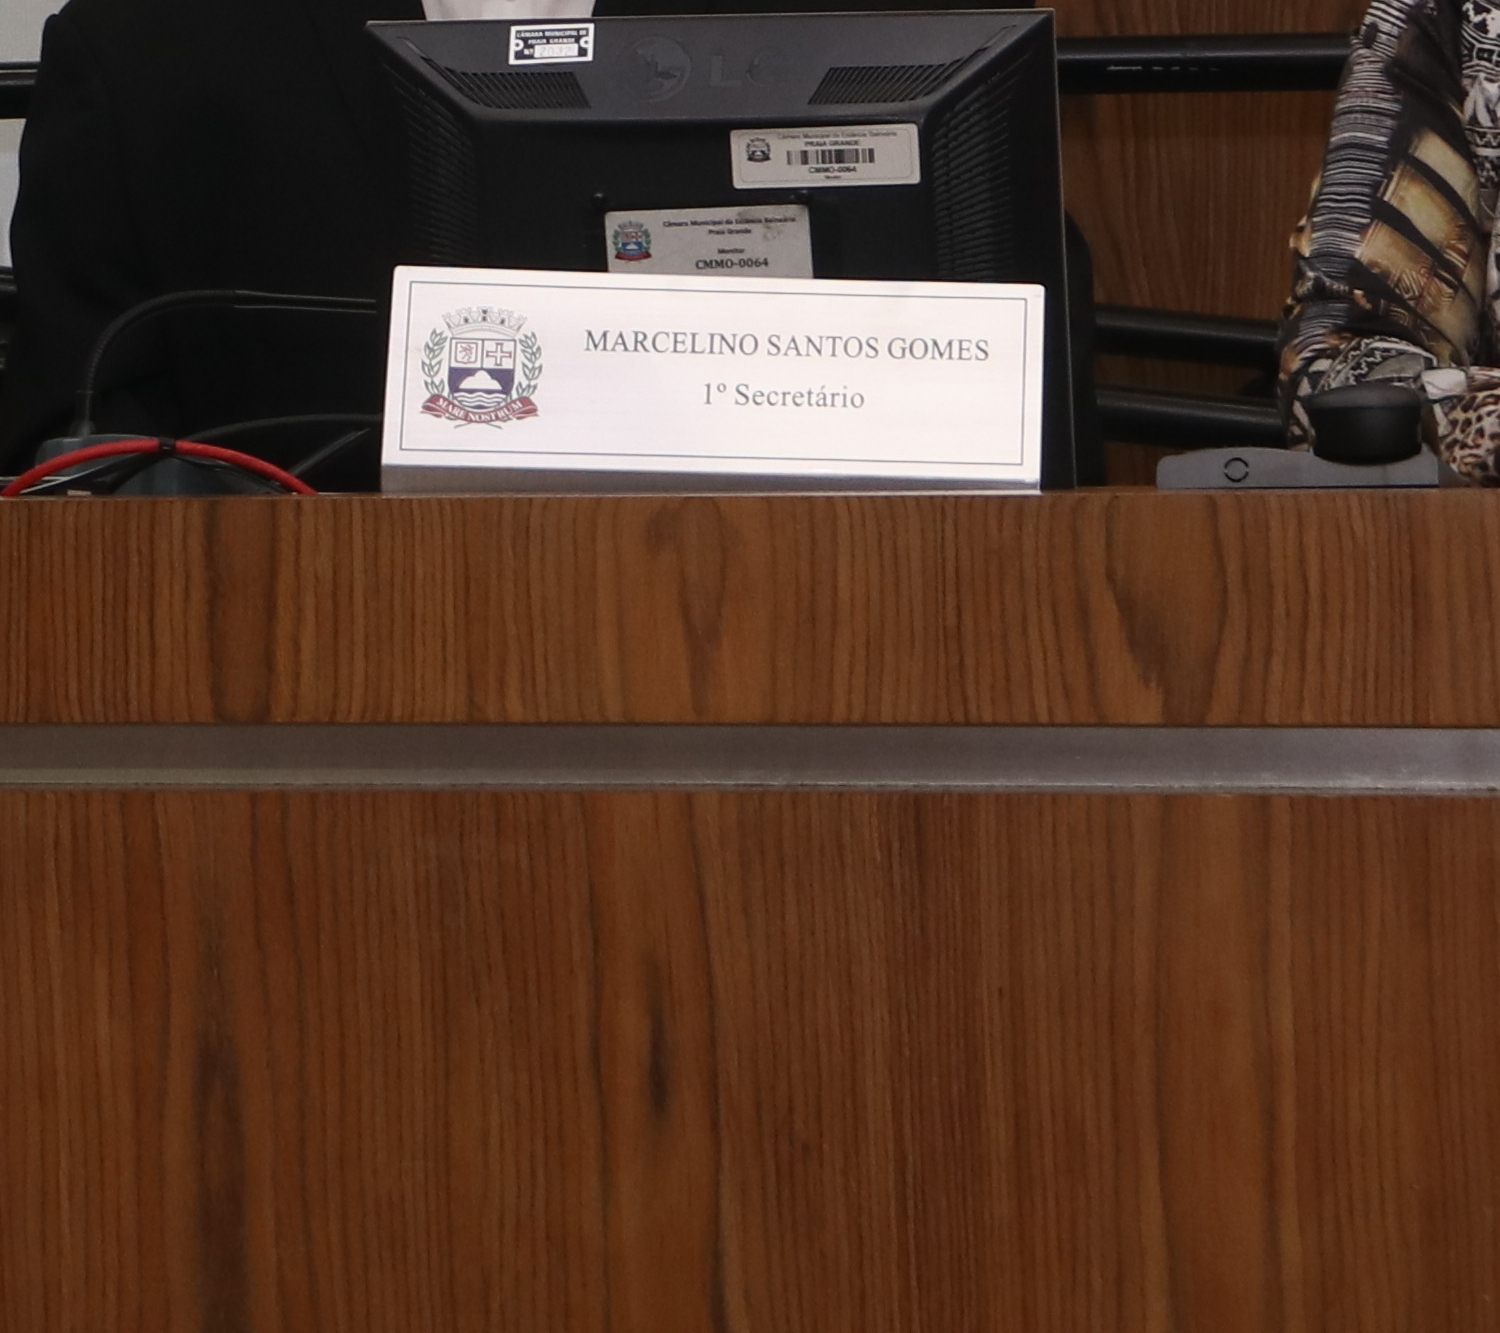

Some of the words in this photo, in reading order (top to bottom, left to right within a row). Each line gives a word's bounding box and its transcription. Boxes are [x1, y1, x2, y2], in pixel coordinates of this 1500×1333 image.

[695, 257, 769, 270] CMMO-0064
[583, 329, 759, 356] MARCELINO
[766, 334, 880, 359] SANTOS
[887, 336, 990, 362] GOMES
[704, 382, 727, 406] 1º
[734, 382, 865, 409] Secretário
[435, 397, 466, 419] MARE
